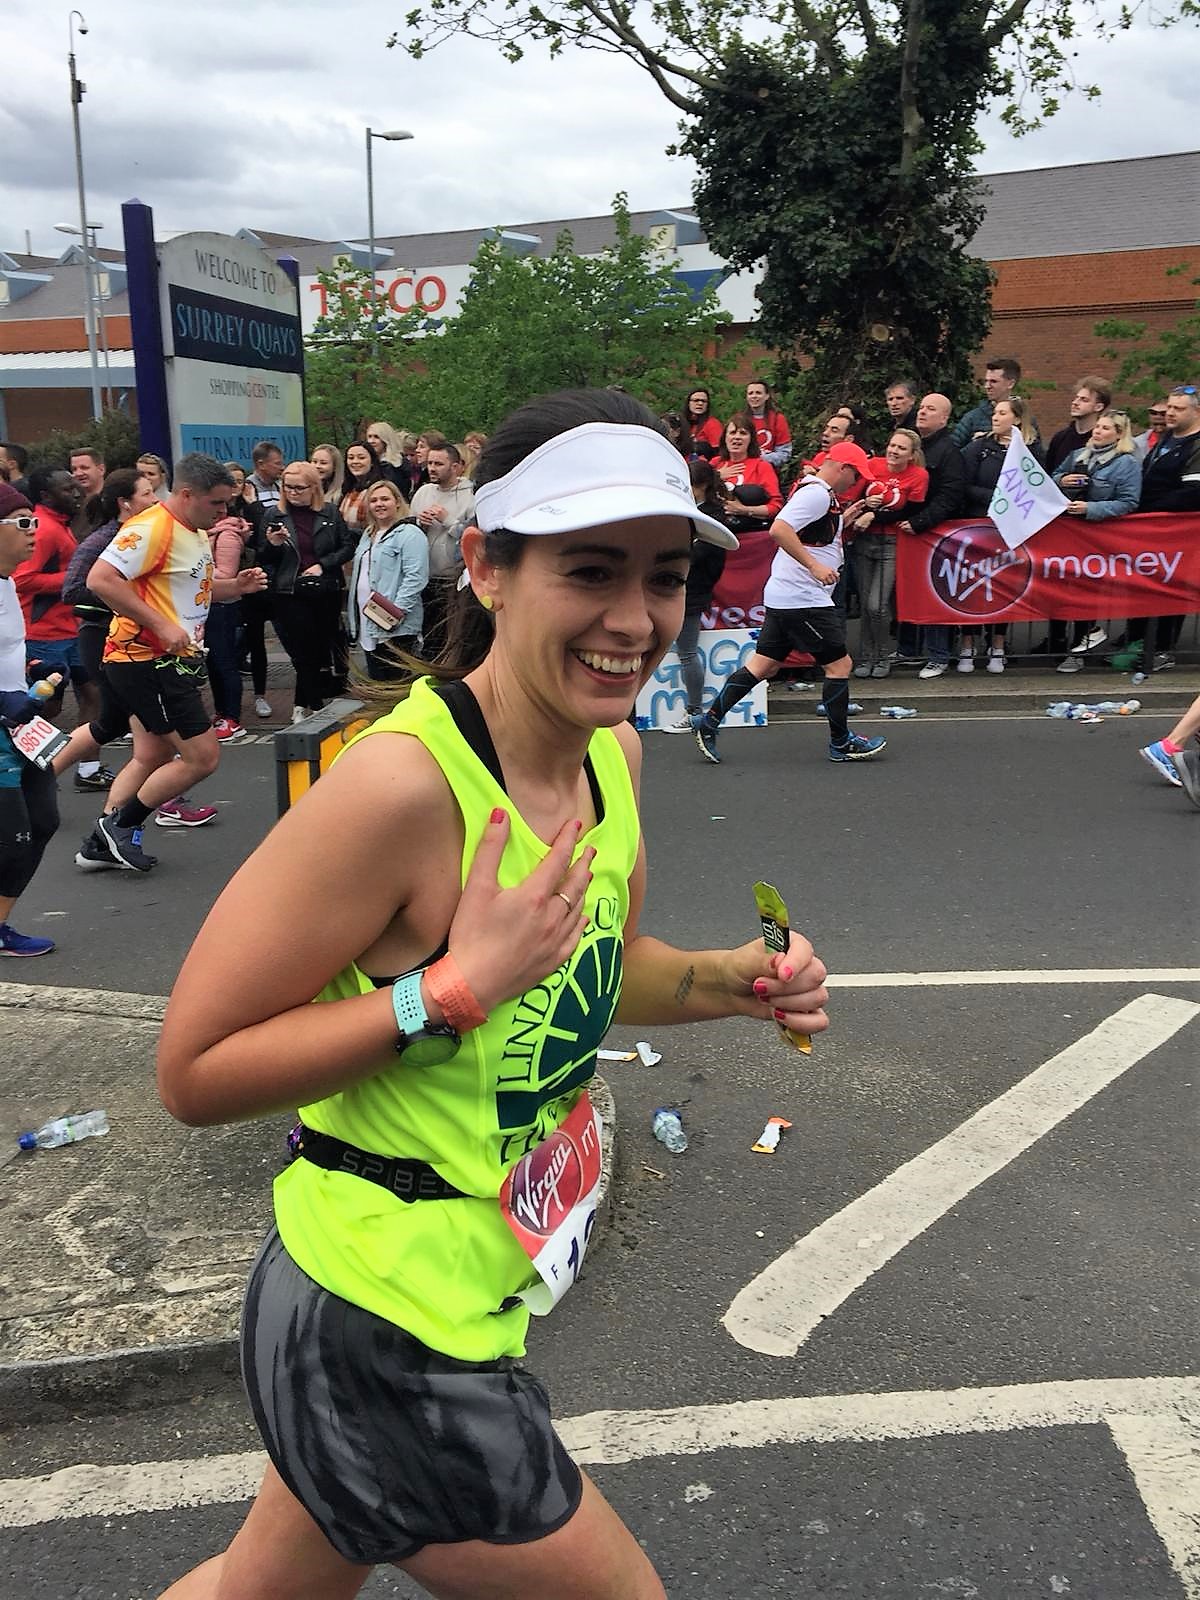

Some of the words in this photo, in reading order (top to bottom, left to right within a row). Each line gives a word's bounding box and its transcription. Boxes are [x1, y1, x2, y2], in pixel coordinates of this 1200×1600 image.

[195, 249, 258, 290] WELCOME
[260, 270, 276, 294] TO
[176, 303, 244, 346] SURREY
[248, 320, 297, 359] QUAYS
[209, 378, 251, 398] SHOPPING
[253, 383, 281, 400] CENTRE
[192, 436, 234, 460] TURN
[1021, 456, 1045, 486] GO
[1000, 467, 1035, 520] ANA
[938, 537, 1025, 602] Virgin
[1043, 551, 1184, 584] money
[516, 1143, 573, 1230] Virgin
